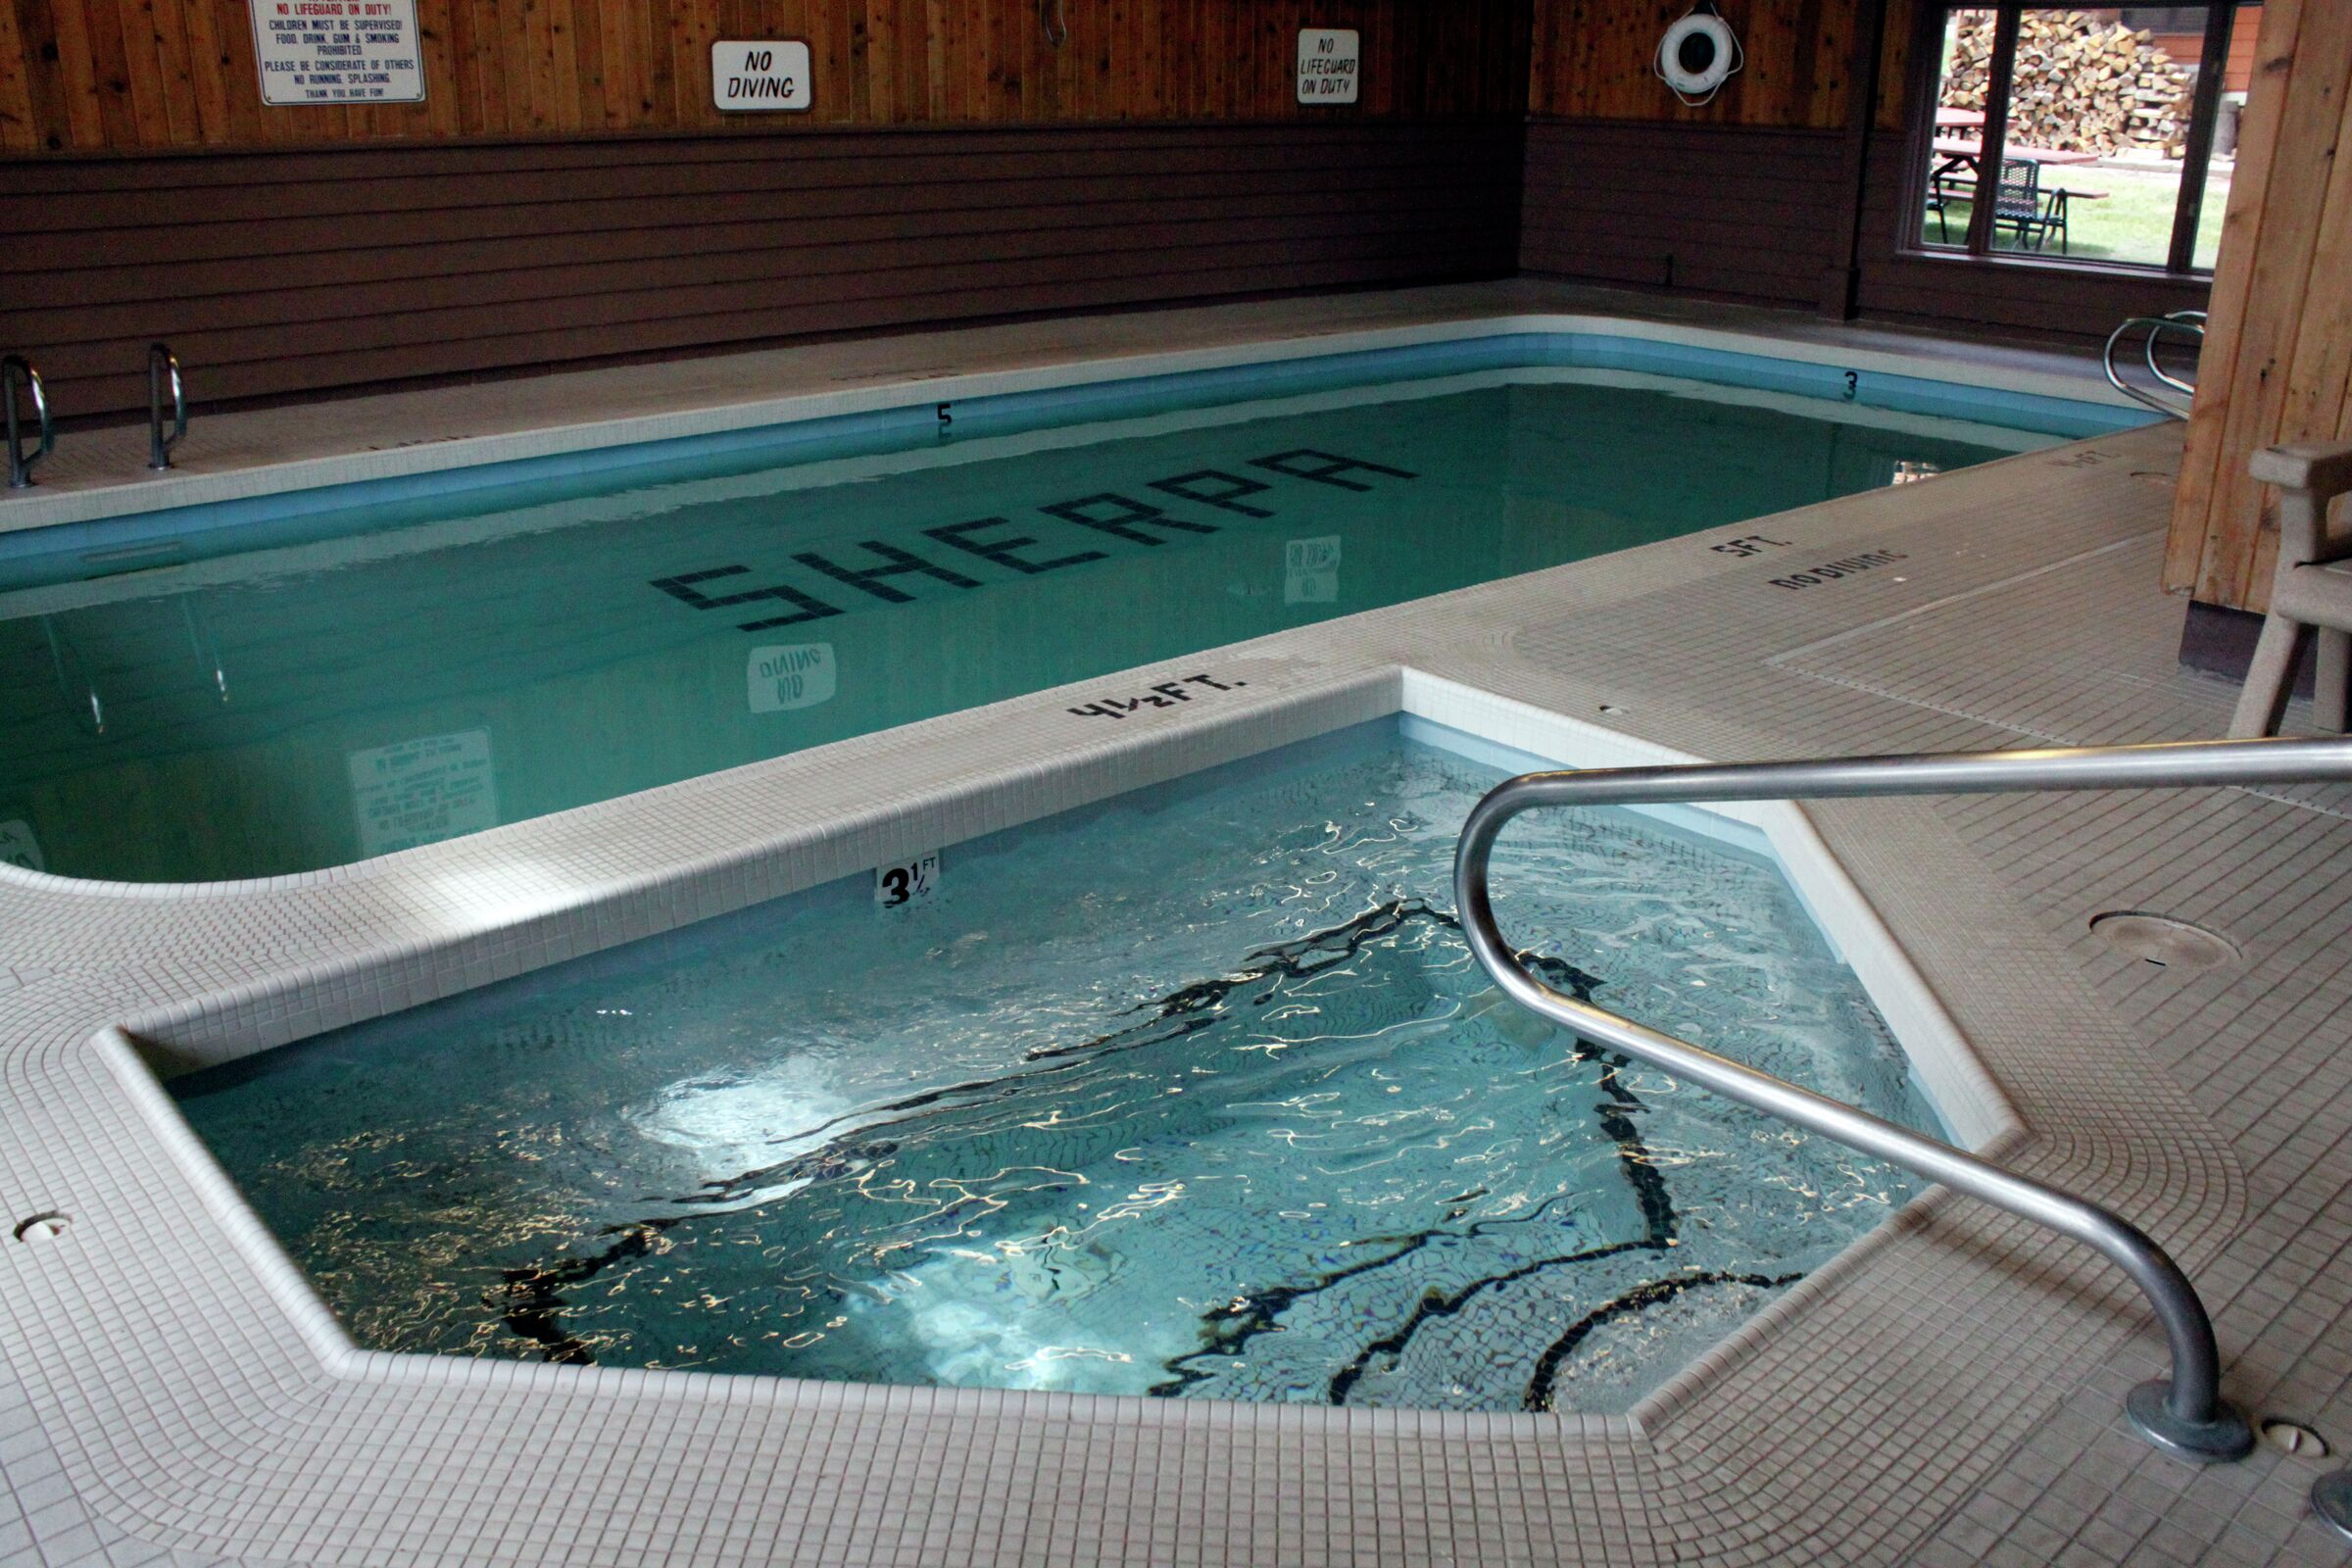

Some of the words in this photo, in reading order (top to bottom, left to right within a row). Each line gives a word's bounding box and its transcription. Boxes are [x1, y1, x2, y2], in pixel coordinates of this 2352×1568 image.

[276, 3, 289, 16] NO
[294, 3, 342, 16] LIFEGUARD
[348, 3, 360, 16] ON
[365, 3, 392, 16] DUTY!
[269, 20, 308, 30] CHILDREN
[312, 20, 334, 30] MUST
[339, 20, 350, 30] BE
[354, 20, 403, 30] SUPERVISED!
[332, 33, 350, 44] GUM
[355, 32, 361, 44] &
[366, 32, 400, 44] SMOKING
[1317, 38, 1335, 54] NO
[265, 60, 296, 72] PLEASE
[300, 60, 311, 72] BE
[315, 59, 367, 72] CONSIDERATE
[370, 59, 380, 71] OF
[384, 59, 415, 71] OTHERS
[745, 51, 772, 72] NO
[1300, 59, 1356, 75] LIFEGUARD
[294, 74, 305, 85] NO
[727, 76, 795, 98] DIVING
[1301, 78, 1316, 95] ON
[1320, 78, 1350, 95] DUTY
[305, 88, 328, 99] THANK
[349, 87, 367, 98] HAVE
[937, 402, 953, 425] 5
[648, 448, 1419, 632] SHERPA
